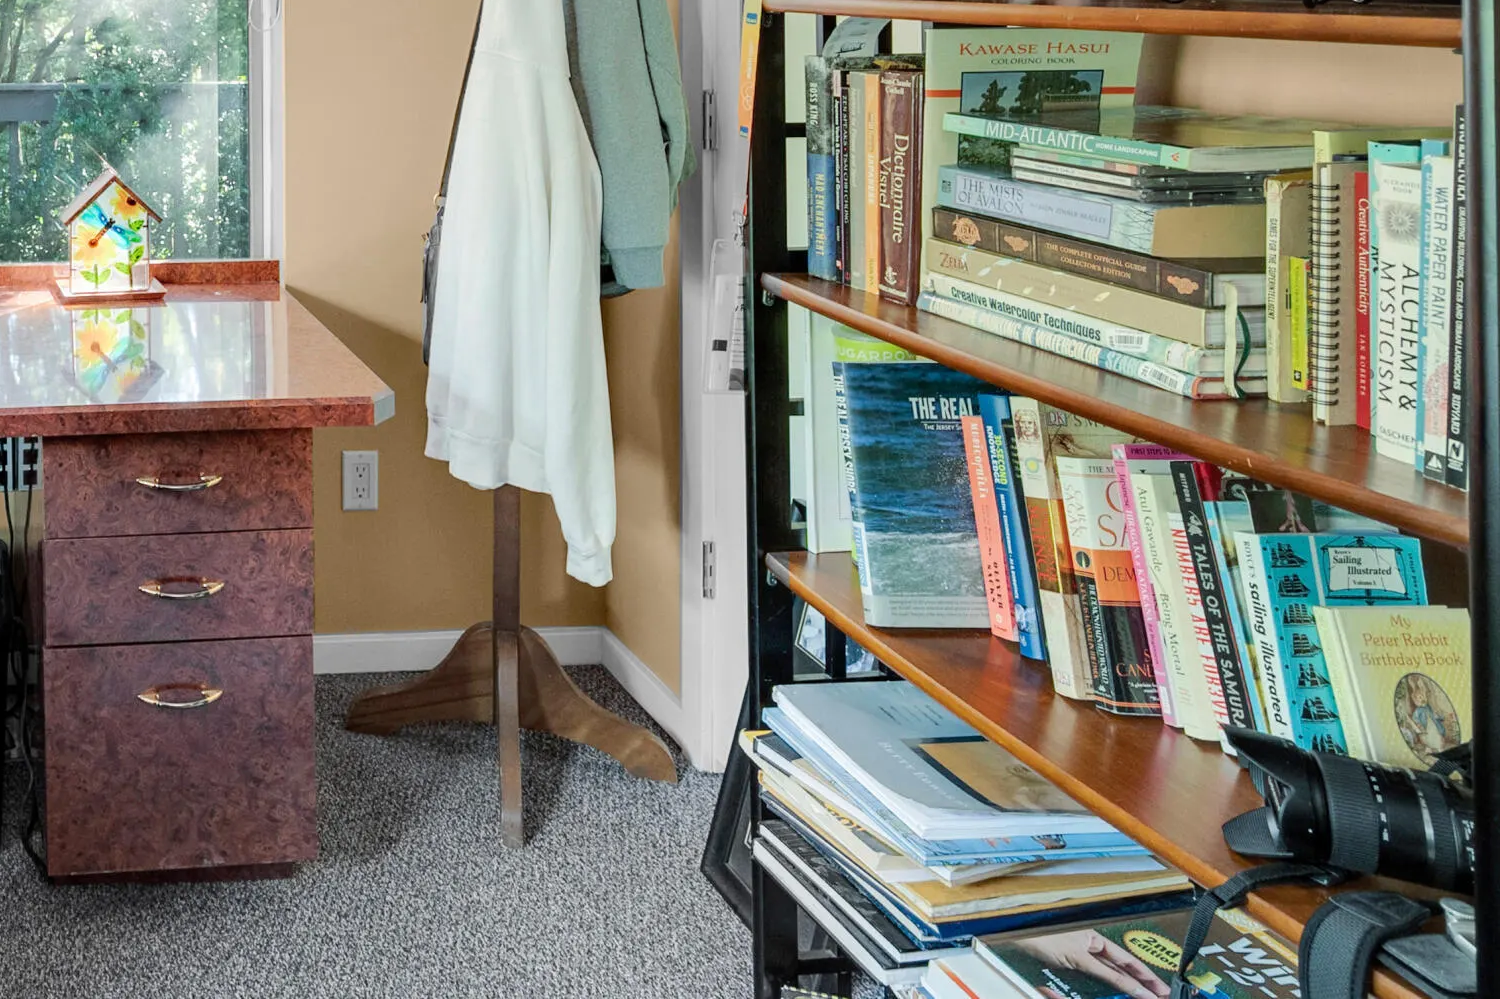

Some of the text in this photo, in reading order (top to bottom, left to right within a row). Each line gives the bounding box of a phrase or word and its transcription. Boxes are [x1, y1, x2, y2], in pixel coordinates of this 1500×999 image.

[960, 42, 1110, 56] KAWASE HASUI
[991, 57, 1042, 65] COLORING
[810, 82, 818, 126] ROSS KING
[985, 120, 1158, 158] MID-ATLANTIC HOME LANDSCAPING
[879, 157, 892, 209] Visuel
[892, 133, 909, 244] Dictionnaire
[962, 178, 985, 194] THE
[988, 182, 1024, 199] MISTS
[815, 174, 825, 256] MAD ENCHANTMENT
[958, 191, 975, 204] OF
[977, 194, 1025, 215] AVALON
[1357, 197, 1369, 246] Creative
[1457, 206, 1466, 240] DRAWING
[1046, 241, 1148, 273] THE COMPLETE OFFICIAL GUIDE
[1102, 266, 1132, 280] EDITION
[1268, 253, 1277, 265] THE
[1430, 187, 1449, 330] WATER PAPER PAINT
[1267, 266, 1277, 320] SUPERINTELLIGENT
[1356, 248, 1369, 316] Authenticity
[1455, 280, 1464, 302] CITIES
[951, 286, 1101, 341] Creative Watercolor Techniques
[1455, 303, 1463, 320] AND
[1035, 325, 1100, 364] WATERCOLOR
[1378, 261, 1397, 404] MYSTICISM
[1398, 264, 1420, 411] ALCHEMY &
[833, 374, 844, 393] THE
[1359, 354, 1367, 396] ROBERTS
[1453, 345, 1462, 390] LANDSCAPES
[908, 397, 975, 420] THE REAL
[1450, 393, 1462, 435] RIDYARD
[986, 425, 1000, 484] KNOWLEDGE
[1065, 484, 1080, 538] SAGAN
[1118, 473, 1130, 507] Japanese
[1125, 509, 1141, 560] HIRAGANA
[1136, 568, 1153, 622] KATAKANA
[1332, 555, 1362, 566] Sailing
[987, 564, 996, 603] SACKS
[993, 561, 1004, 609] OLIVER
[1103, 566, 1137, 582] DEM
[1137, 486, 1185, 676] Atul Gawande Being Mortal
[1347, 566, 1392, 576] Illustrated
[1179, 472, 1246, 728] MITFORD TALES OF THE SAMURA
[1191, 613, 1211, 645] ARE
[1362, 632, 1449, 648] Peter Rabbit
[1389, 614, 1412, 629] My
[1098, 656, 1109, 684] WORLD
[1250, 582, 1266, 636] sailing
[1260, 640, 1288, 727] illustrated
[1360, 652, 1464, 668] Birthday Book
[1128, 937, 1178, 968] Edition
[1147, 935, 1180, 959] 2nd
